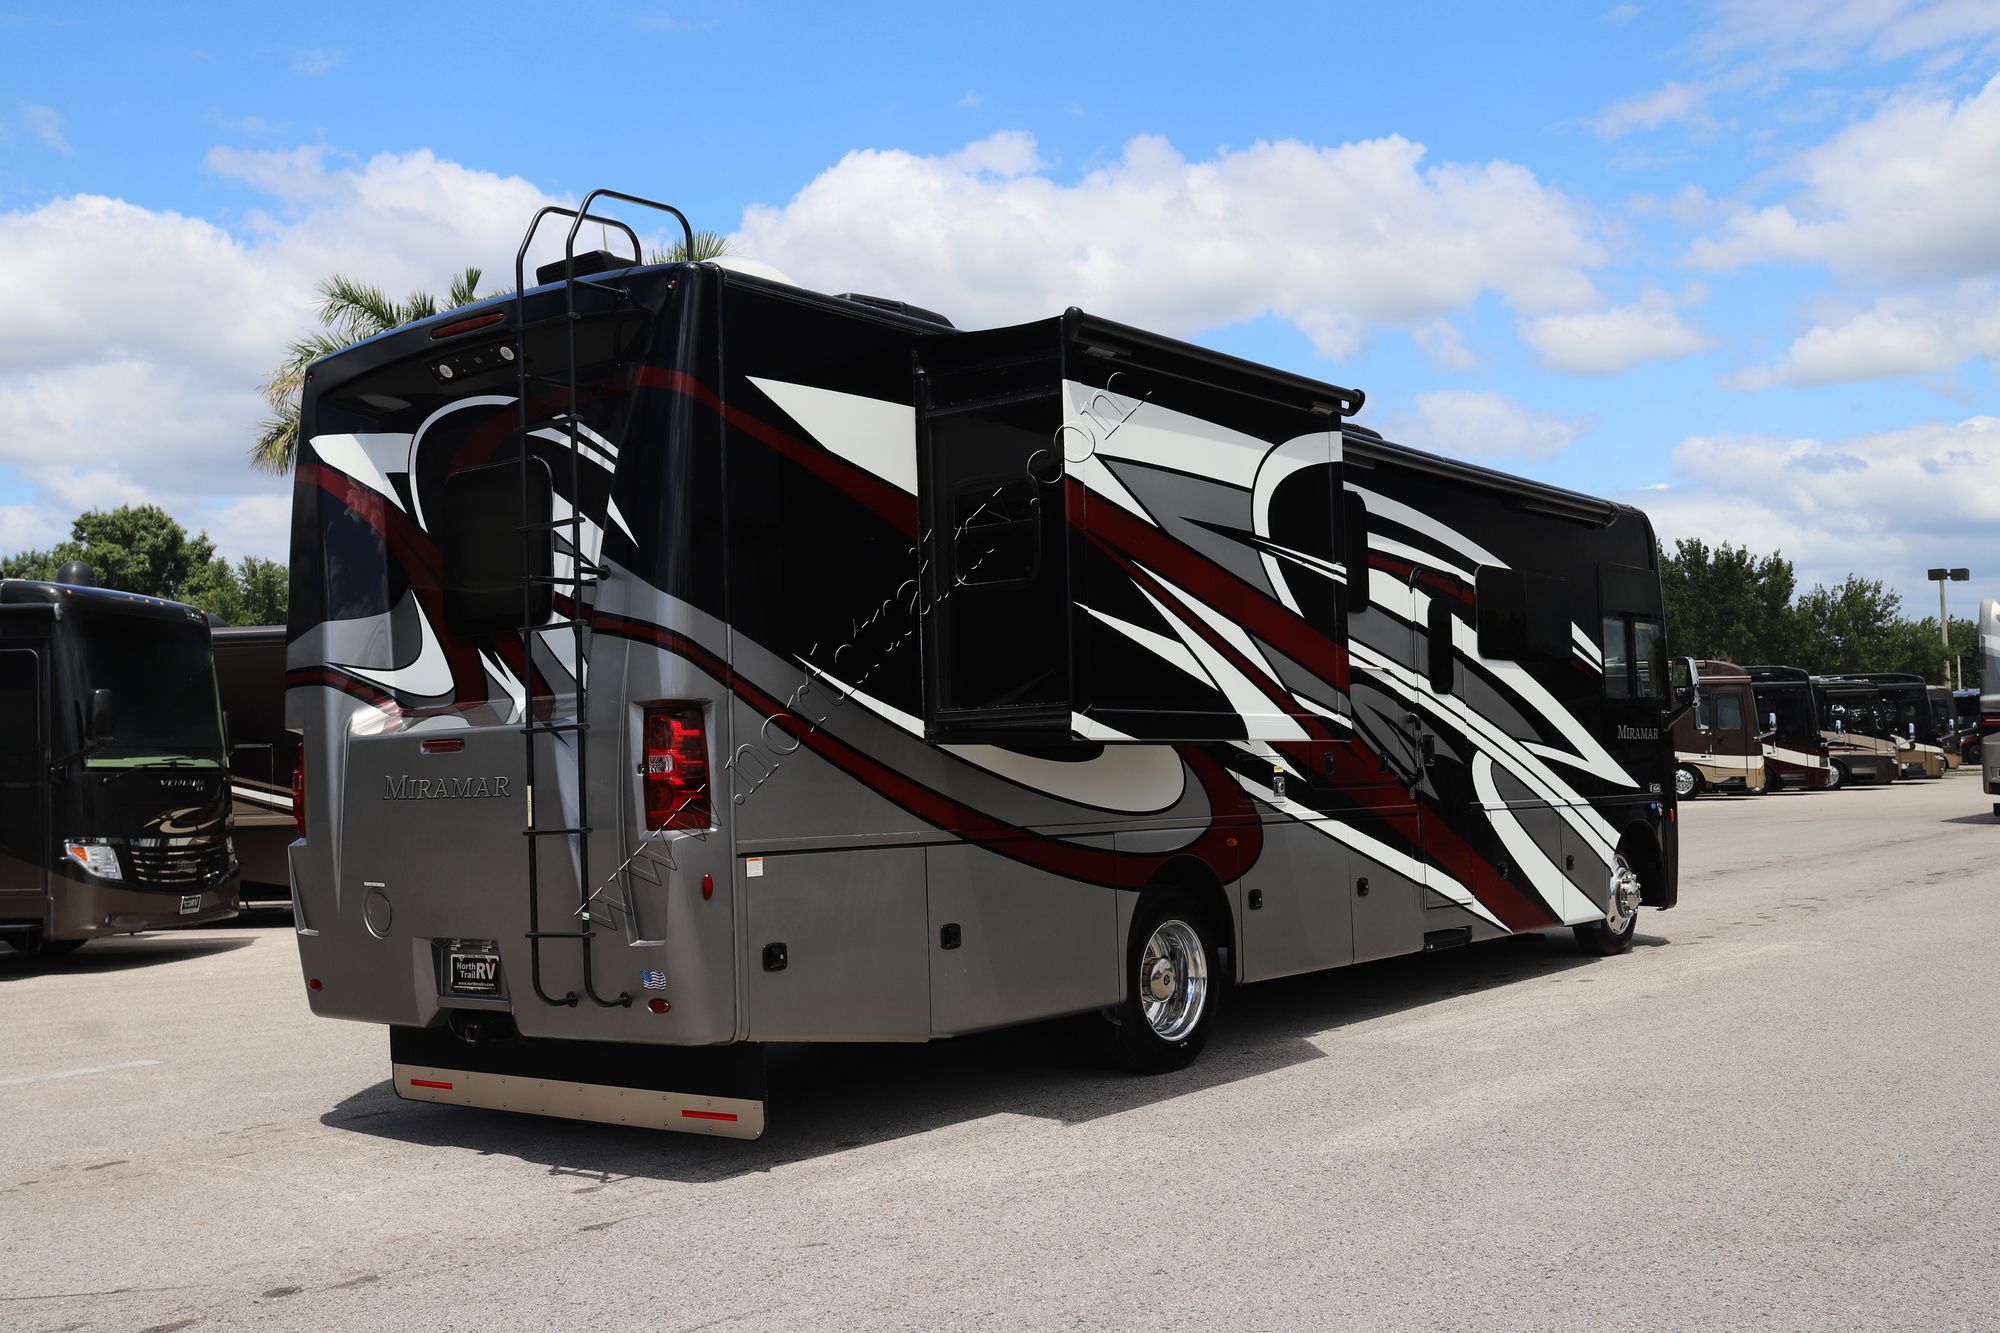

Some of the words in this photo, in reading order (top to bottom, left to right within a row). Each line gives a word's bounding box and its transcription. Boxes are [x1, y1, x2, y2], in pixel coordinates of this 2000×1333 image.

[383, 774, 511, 800] MIRAMAR
[456, 962, 475, 970] North
[476, 962, 496, 980] RV
[460, 971, 475, 979] Trail
